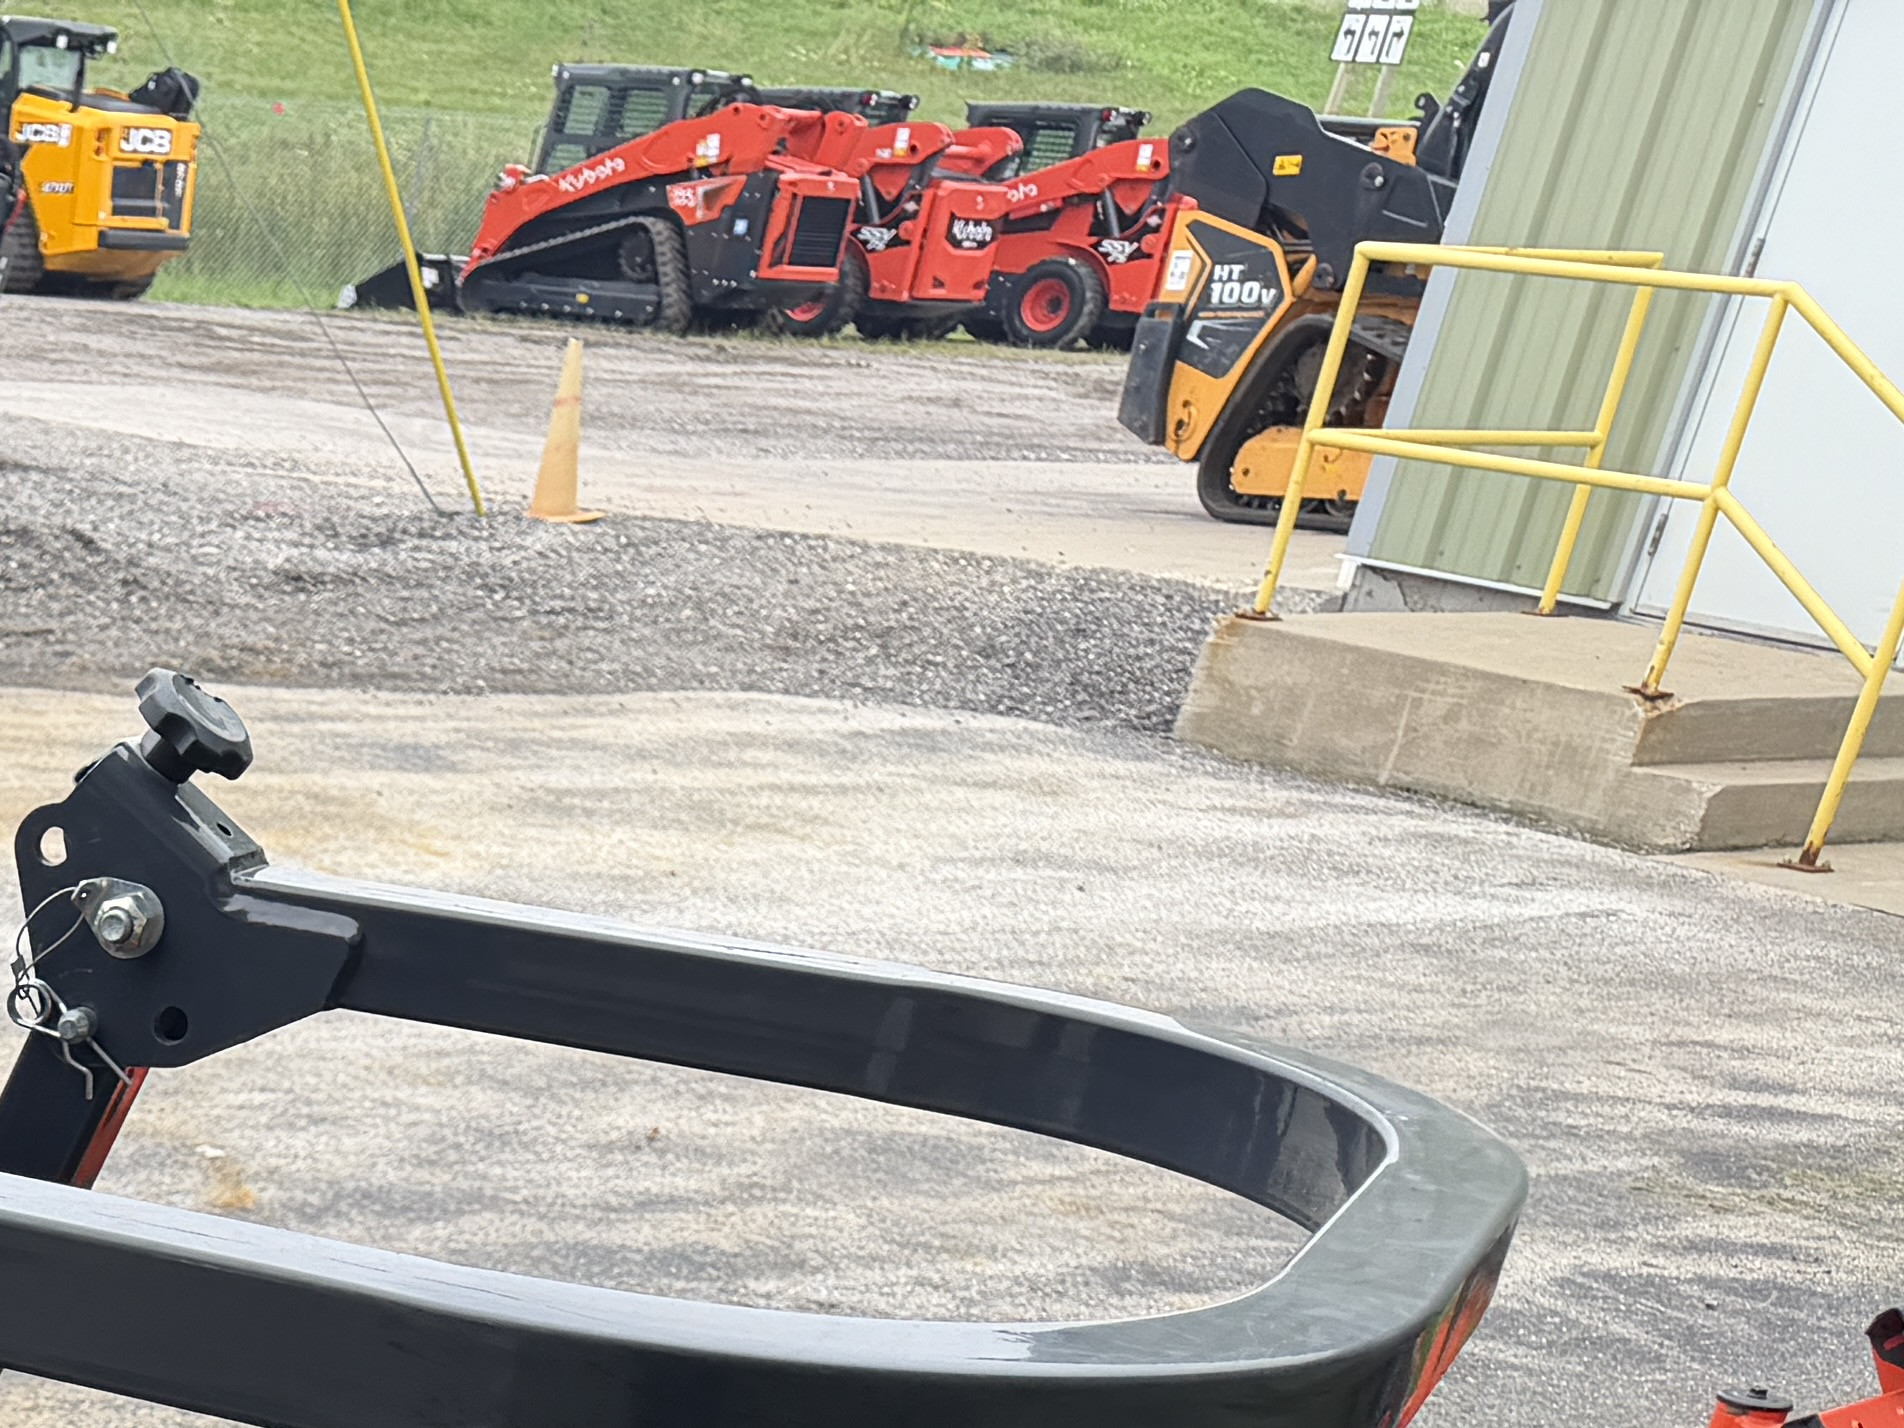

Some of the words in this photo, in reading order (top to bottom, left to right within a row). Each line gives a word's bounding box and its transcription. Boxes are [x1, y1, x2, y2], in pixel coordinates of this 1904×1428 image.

[16, 124, 59, 143] JCB
[121, 128, 171, 153] JCB
[558, 157, 626, 194] Kubota
[1214, 265, 1245, 281] HT
